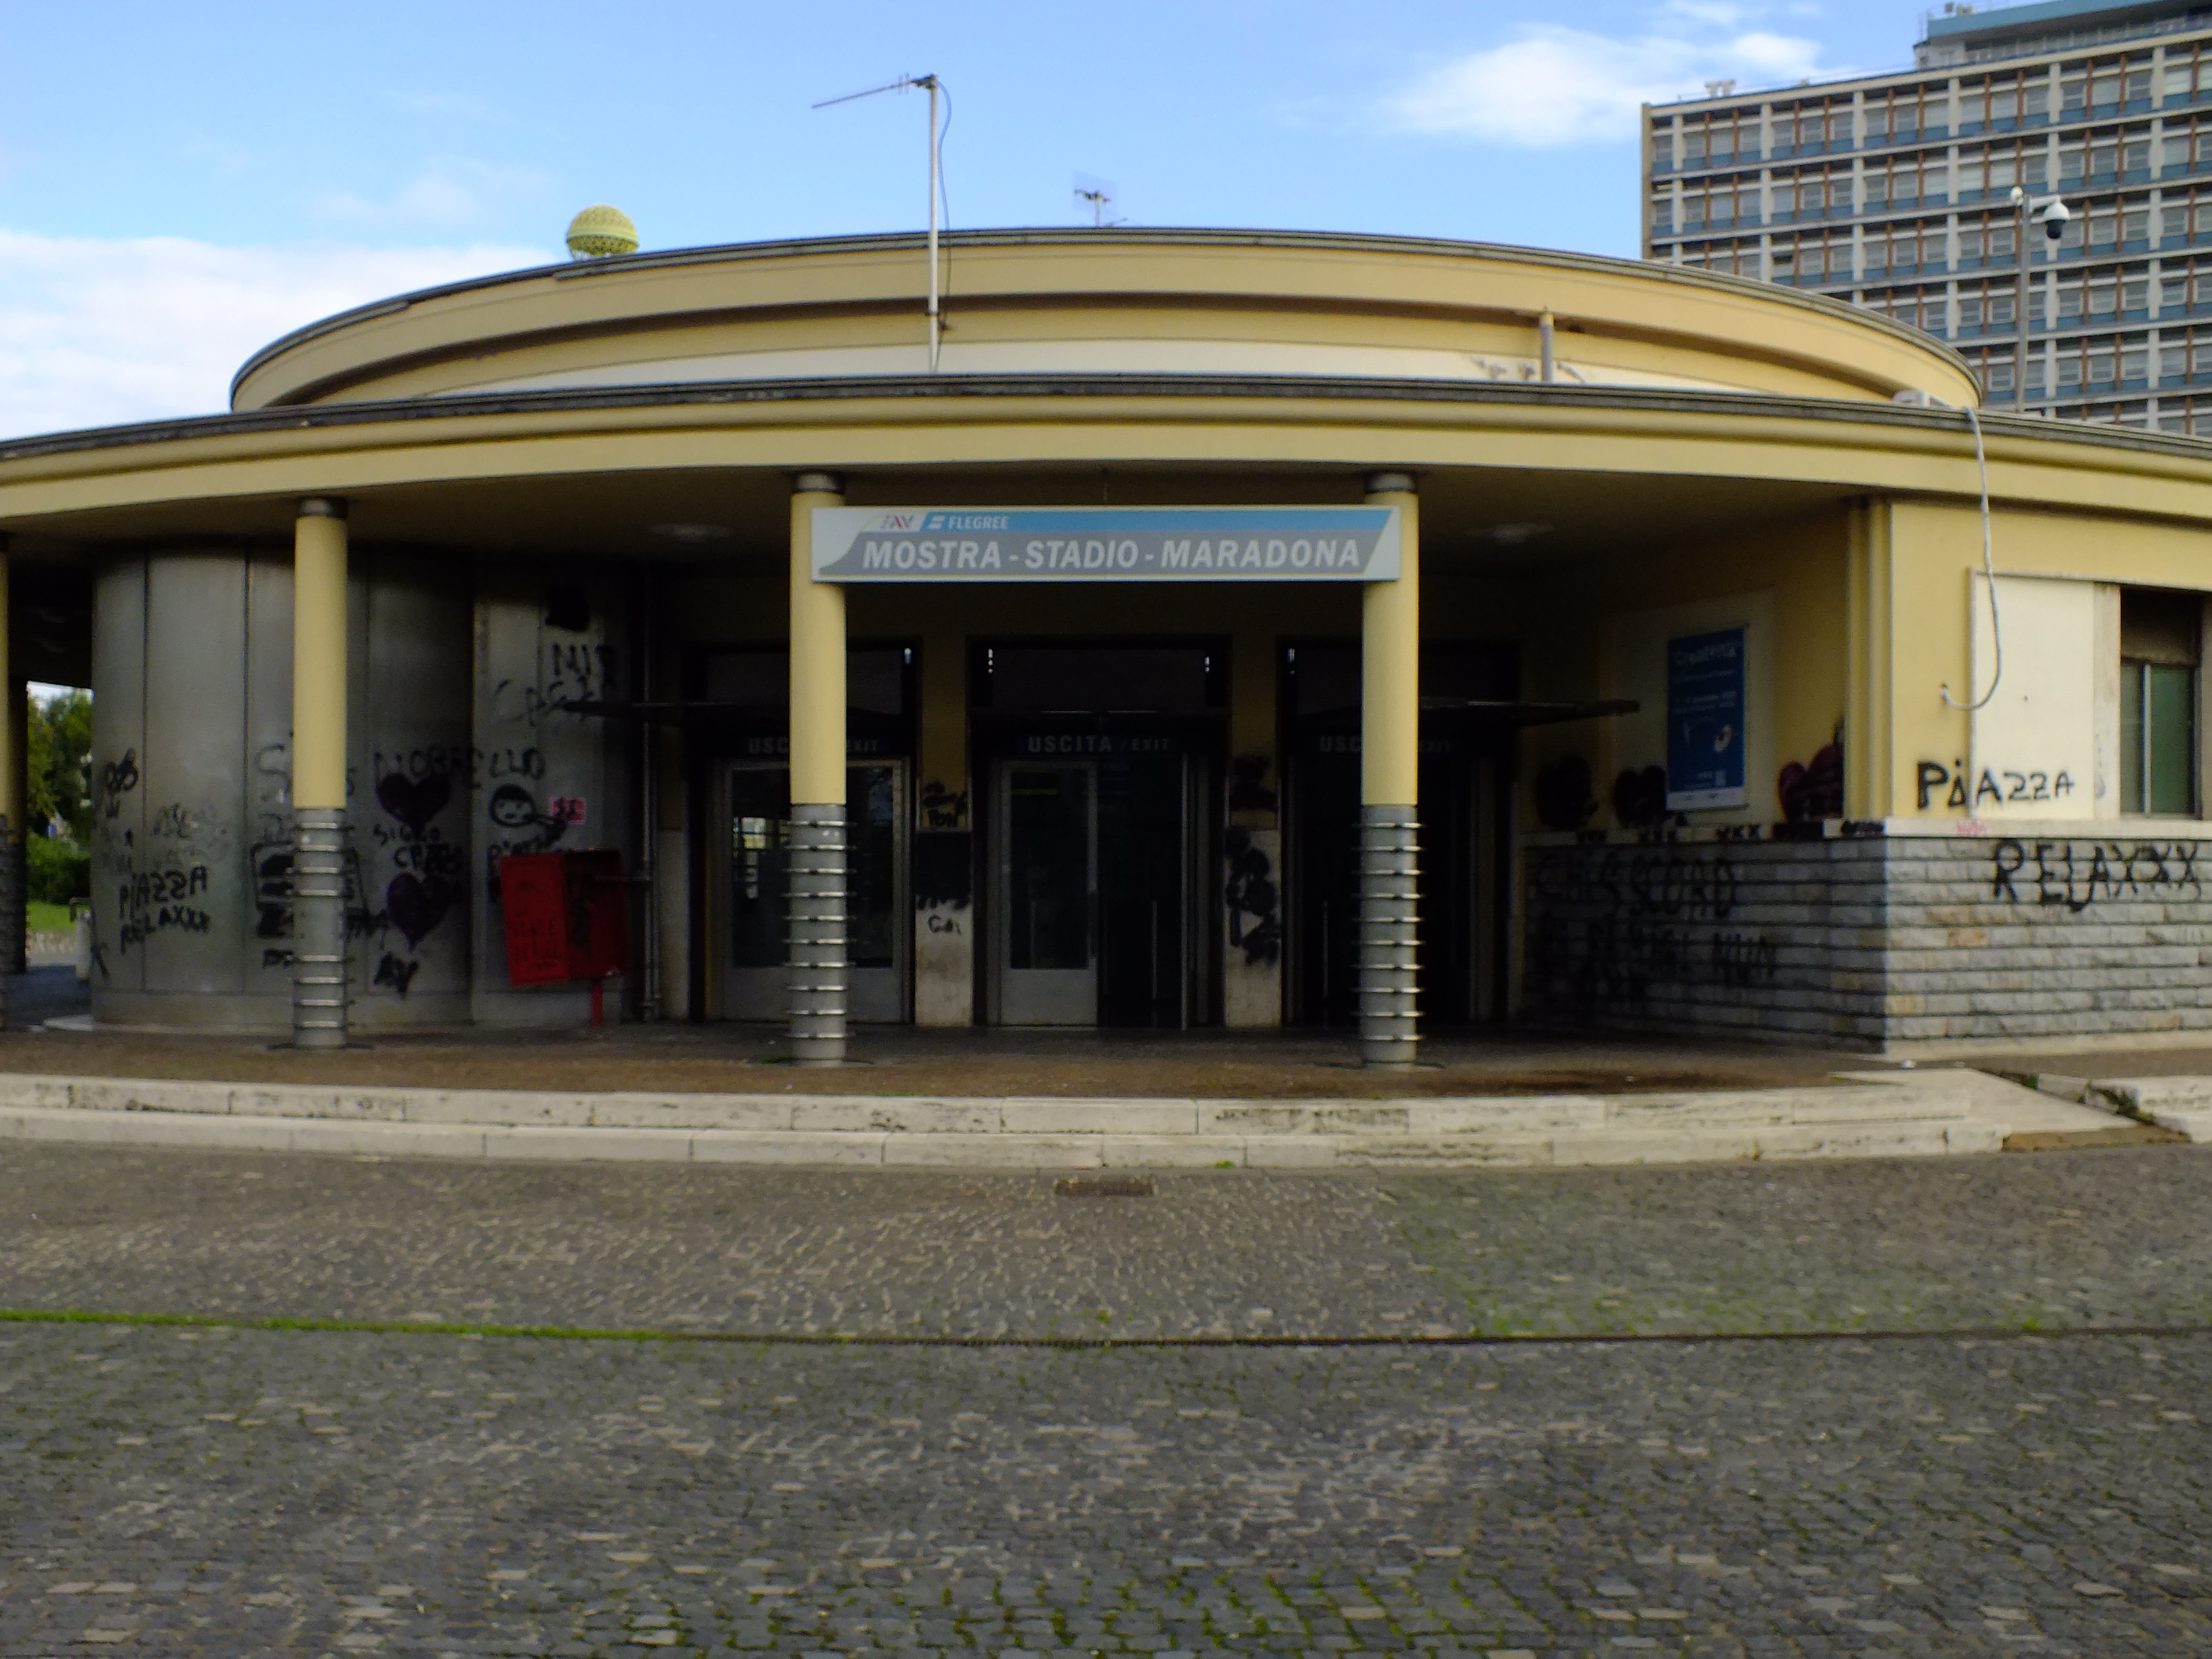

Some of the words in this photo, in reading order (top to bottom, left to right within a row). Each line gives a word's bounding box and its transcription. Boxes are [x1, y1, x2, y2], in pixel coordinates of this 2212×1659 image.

[948, 515, 1010, 530] FLEGREE
[862, 540, 1002, 570] MOSTRA
[1024, 540, 1139, 569] STADIO
[1161, 539, 1361, 569] MARADONA
[748, 737, 790, 754] USC
[1027, 735, 1112, 753] USCITA
[1132, 738, 1170, 752] EXIT
[1320, 735, 1361, 753] USC
